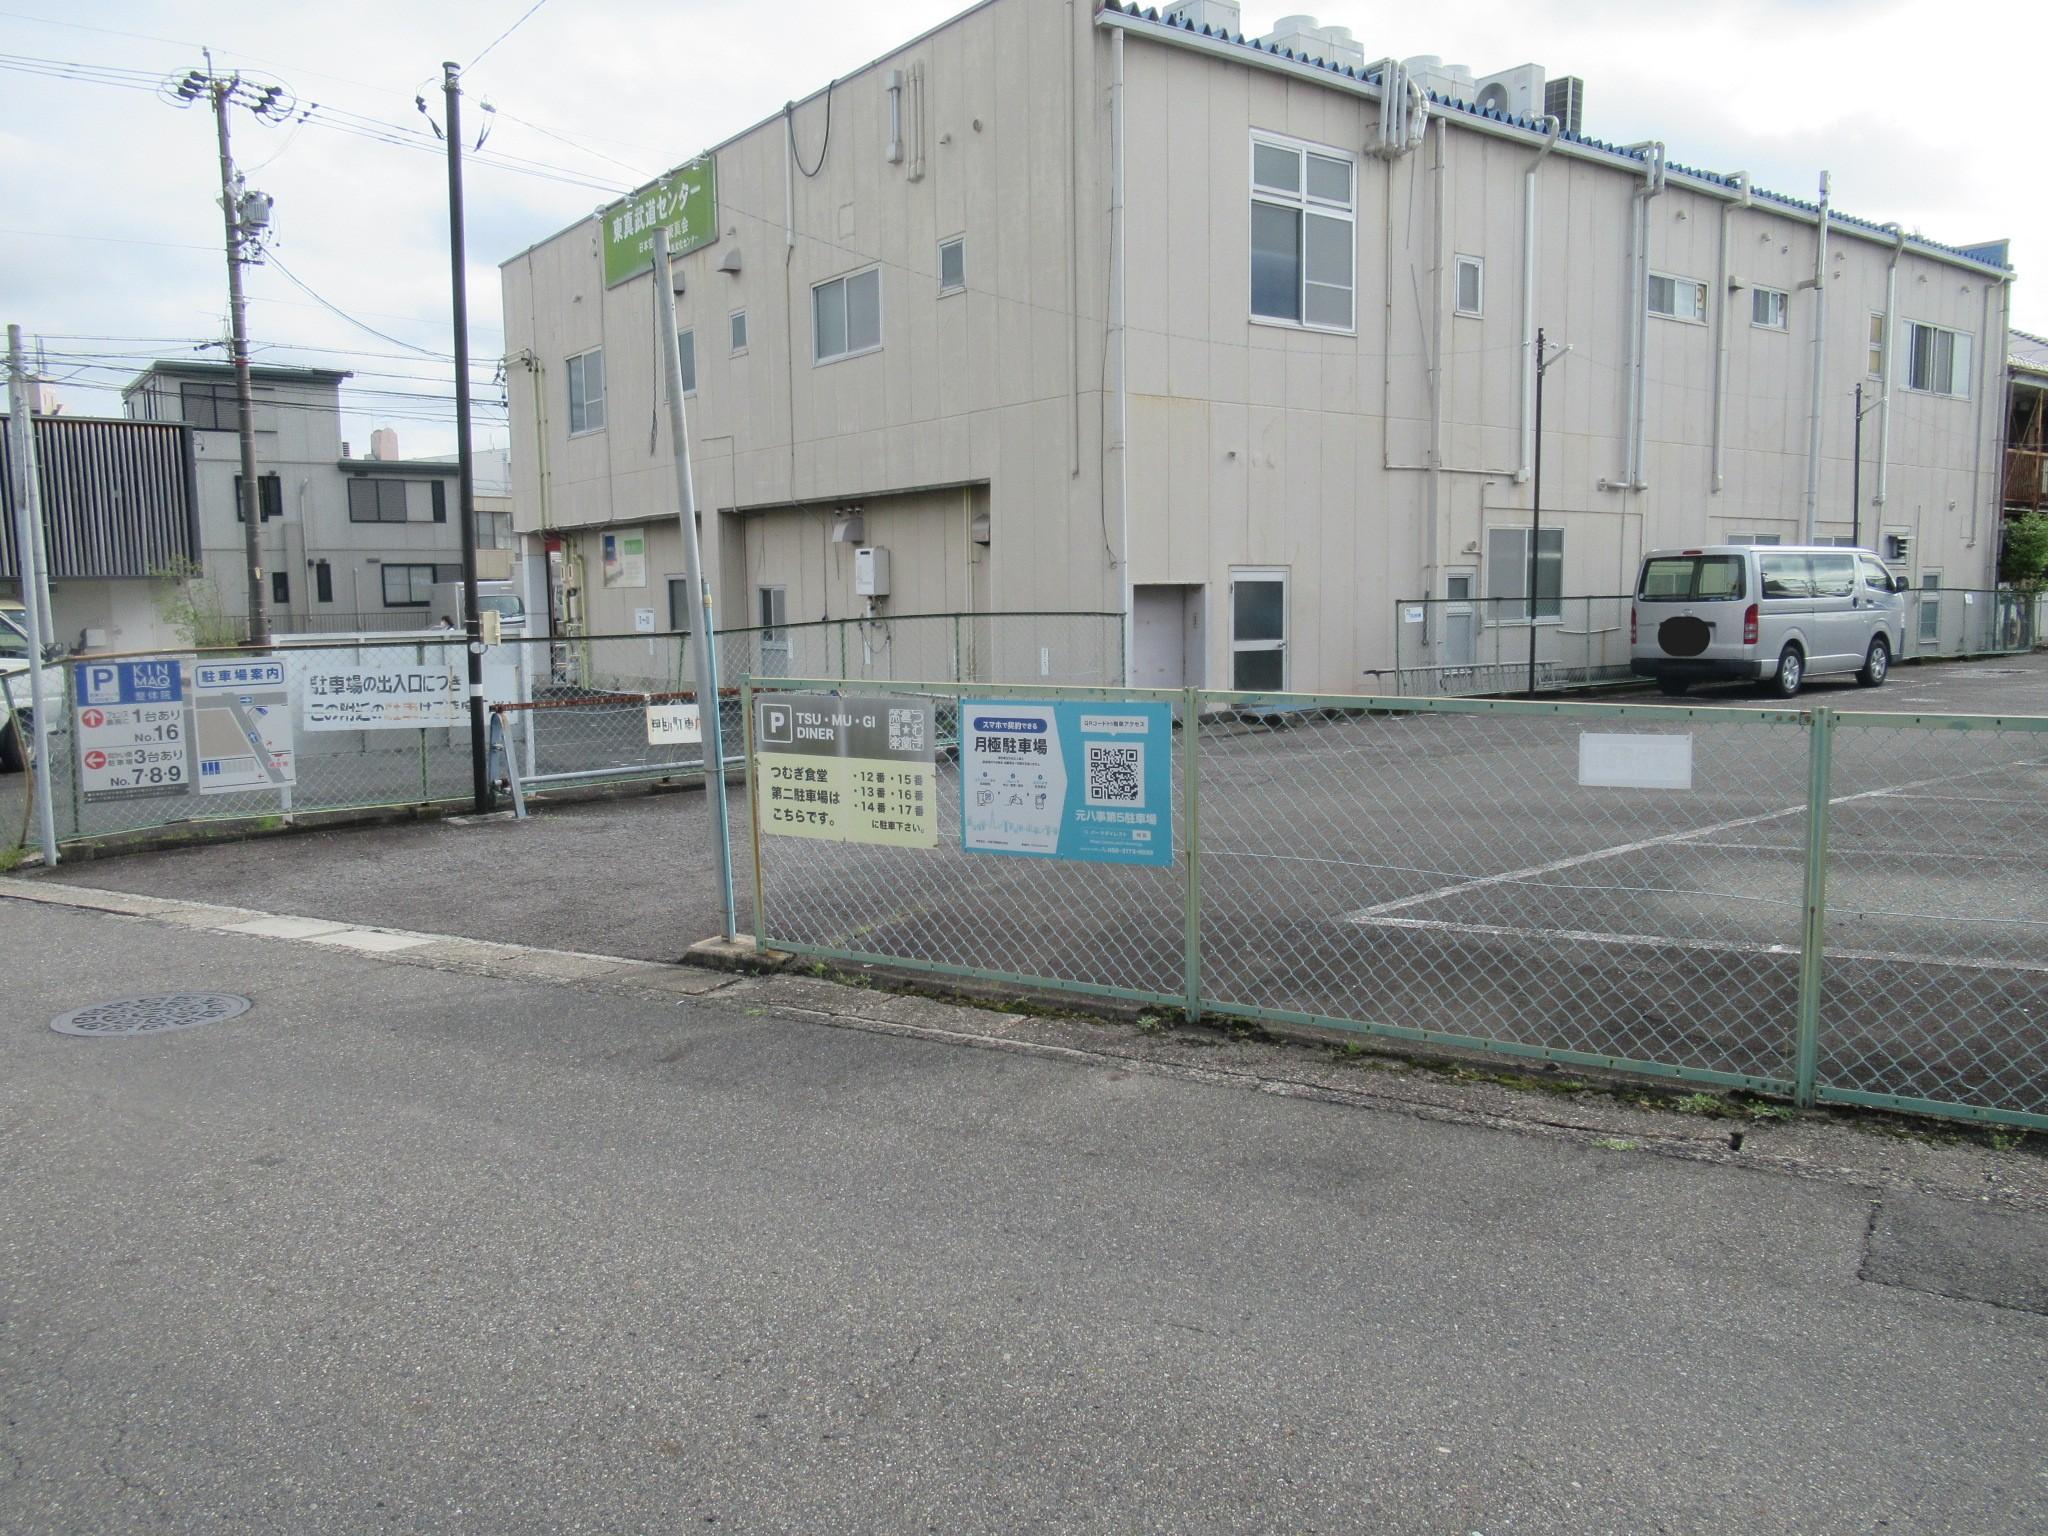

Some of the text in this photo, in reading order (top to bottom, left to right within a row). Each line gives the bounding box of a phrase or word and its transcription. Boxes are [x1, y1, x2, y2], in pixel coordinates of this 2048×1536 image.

[613, 182, 701, 243] 東真武道センター
[93, 668, 114, 692] P
[201, 668, 279, 683] 駐車場案内
[133, 709, 181, 725] 1台あり
[770, 712, 784, 733] P
[982, 720, 1038, 730] スマホで契約できる
[134, 724, 179, 743] No.16
[797, 728, 835, 740] DINER
[975, 737, 1048, 755] 月極駐車場
[133, 749, 183, 764] 3台あり
[771, 767, 828, 782] つむぎ食堂
[771, 786, 840, 804] 第二駐車場は
[773, 809, 836, 826] こちらです。
[1075, 810, 1157, 826] 元八事第5駐車場
[872, 820, 925, 834] に駐車下さい。
